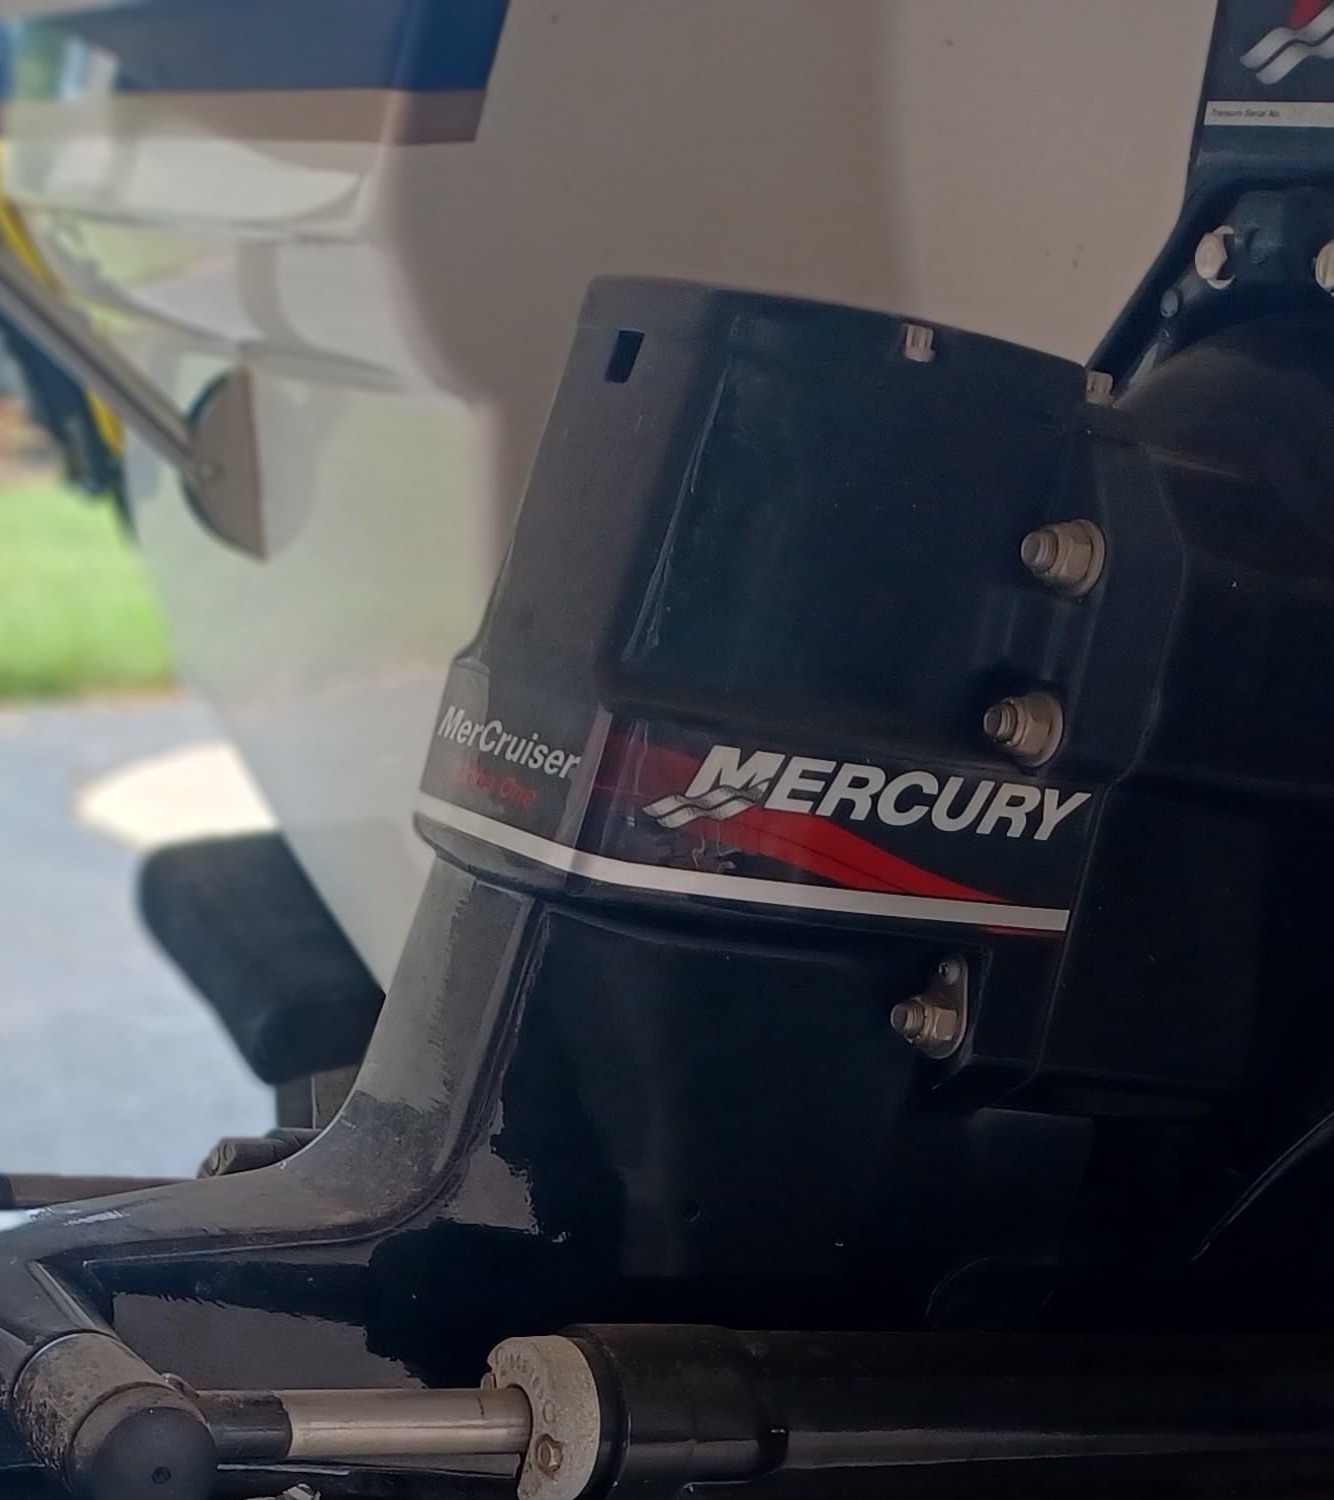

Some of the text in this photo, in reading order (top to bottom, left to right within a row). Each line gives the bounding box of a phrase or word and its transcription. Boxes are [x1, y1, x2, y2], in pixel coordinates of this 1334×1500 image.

[1244, 108, 1268, 118] Serial
[437, 705, 581, 778] MerCruiser
[684, 745, 1091, 841] MERCURY
